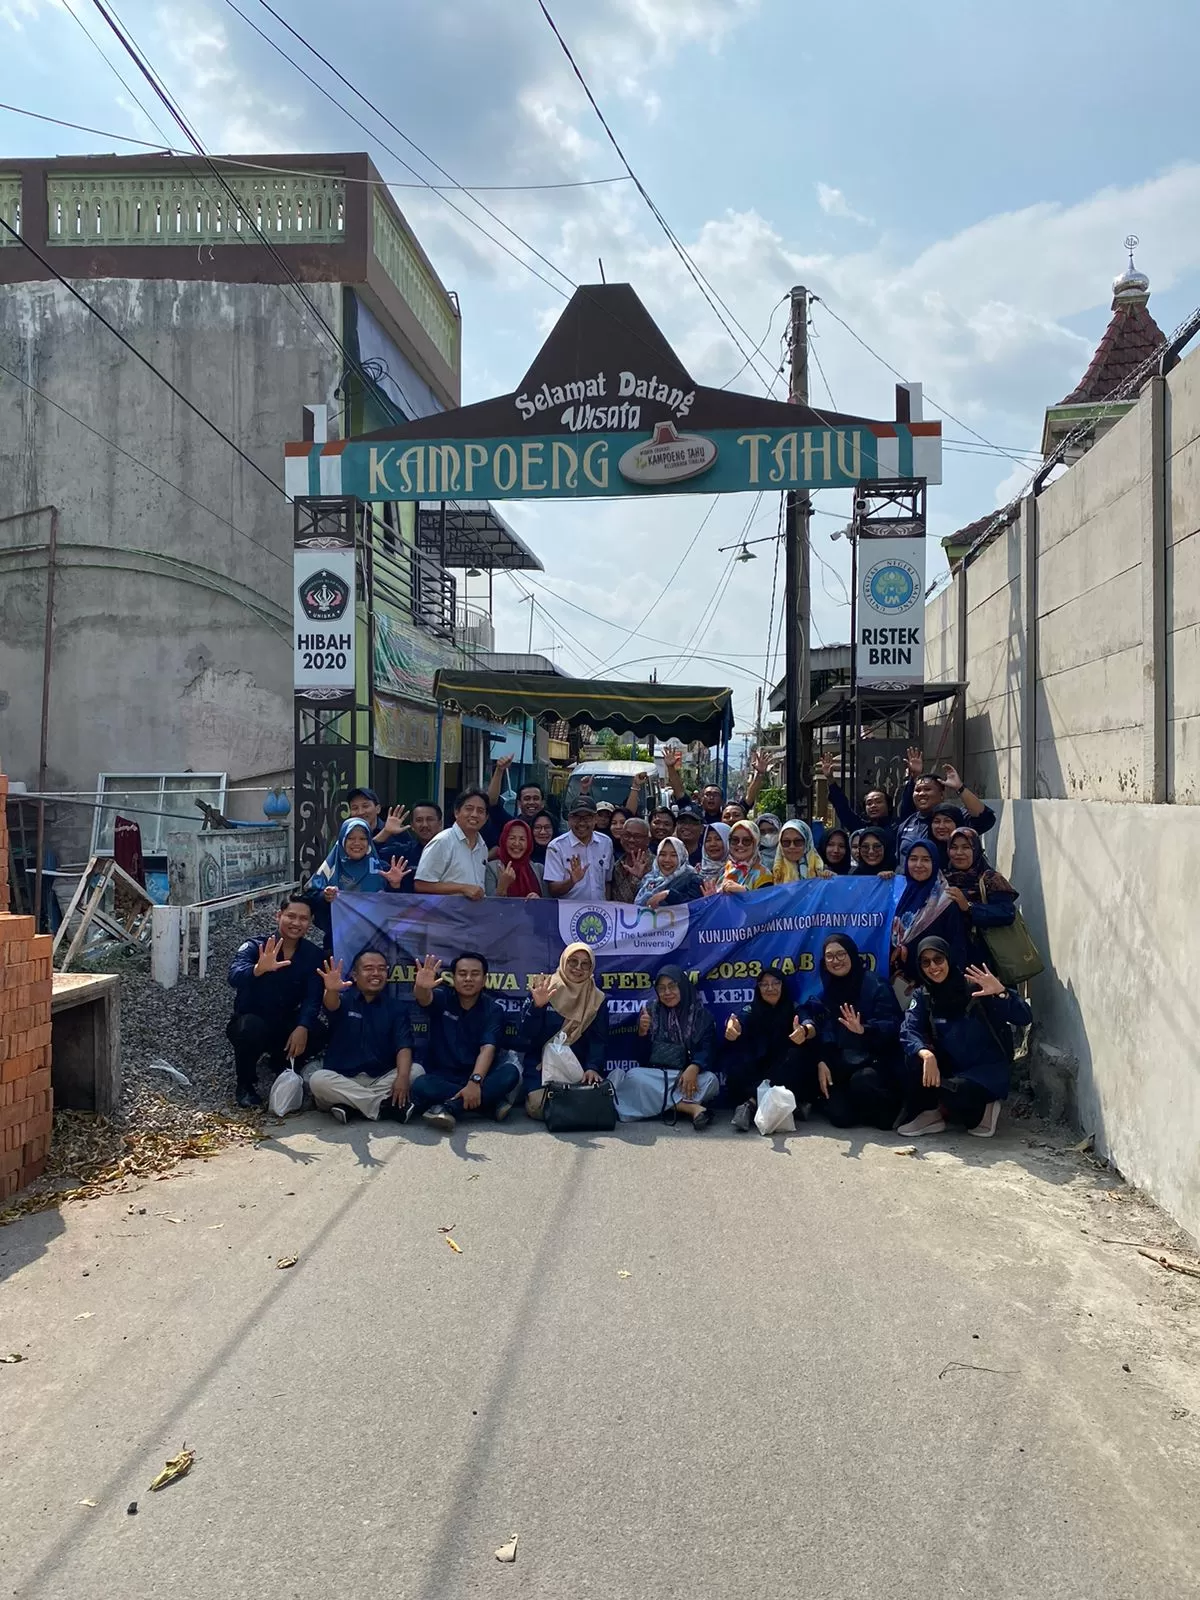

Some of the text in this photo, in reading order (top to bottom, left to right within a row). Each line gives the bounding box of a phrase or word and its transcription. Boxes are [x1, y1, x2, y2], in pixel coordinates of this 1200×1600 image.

[515, 371, 696, 421] Selamat Datang
[369, 431, 861, 494] KAMPOENG TAHU
[648, 447, 705, 466] KAMPOENG TAHU
[298, 634, 352, 650] HIBAH
[862, 628, 920, 646] RISTEK
[302, 652, 346, 670] 2020
[869, 648, 912, 665] BRIN
[620, 929, 675, 940] The Learning
[633, 940, 675, 950] University
